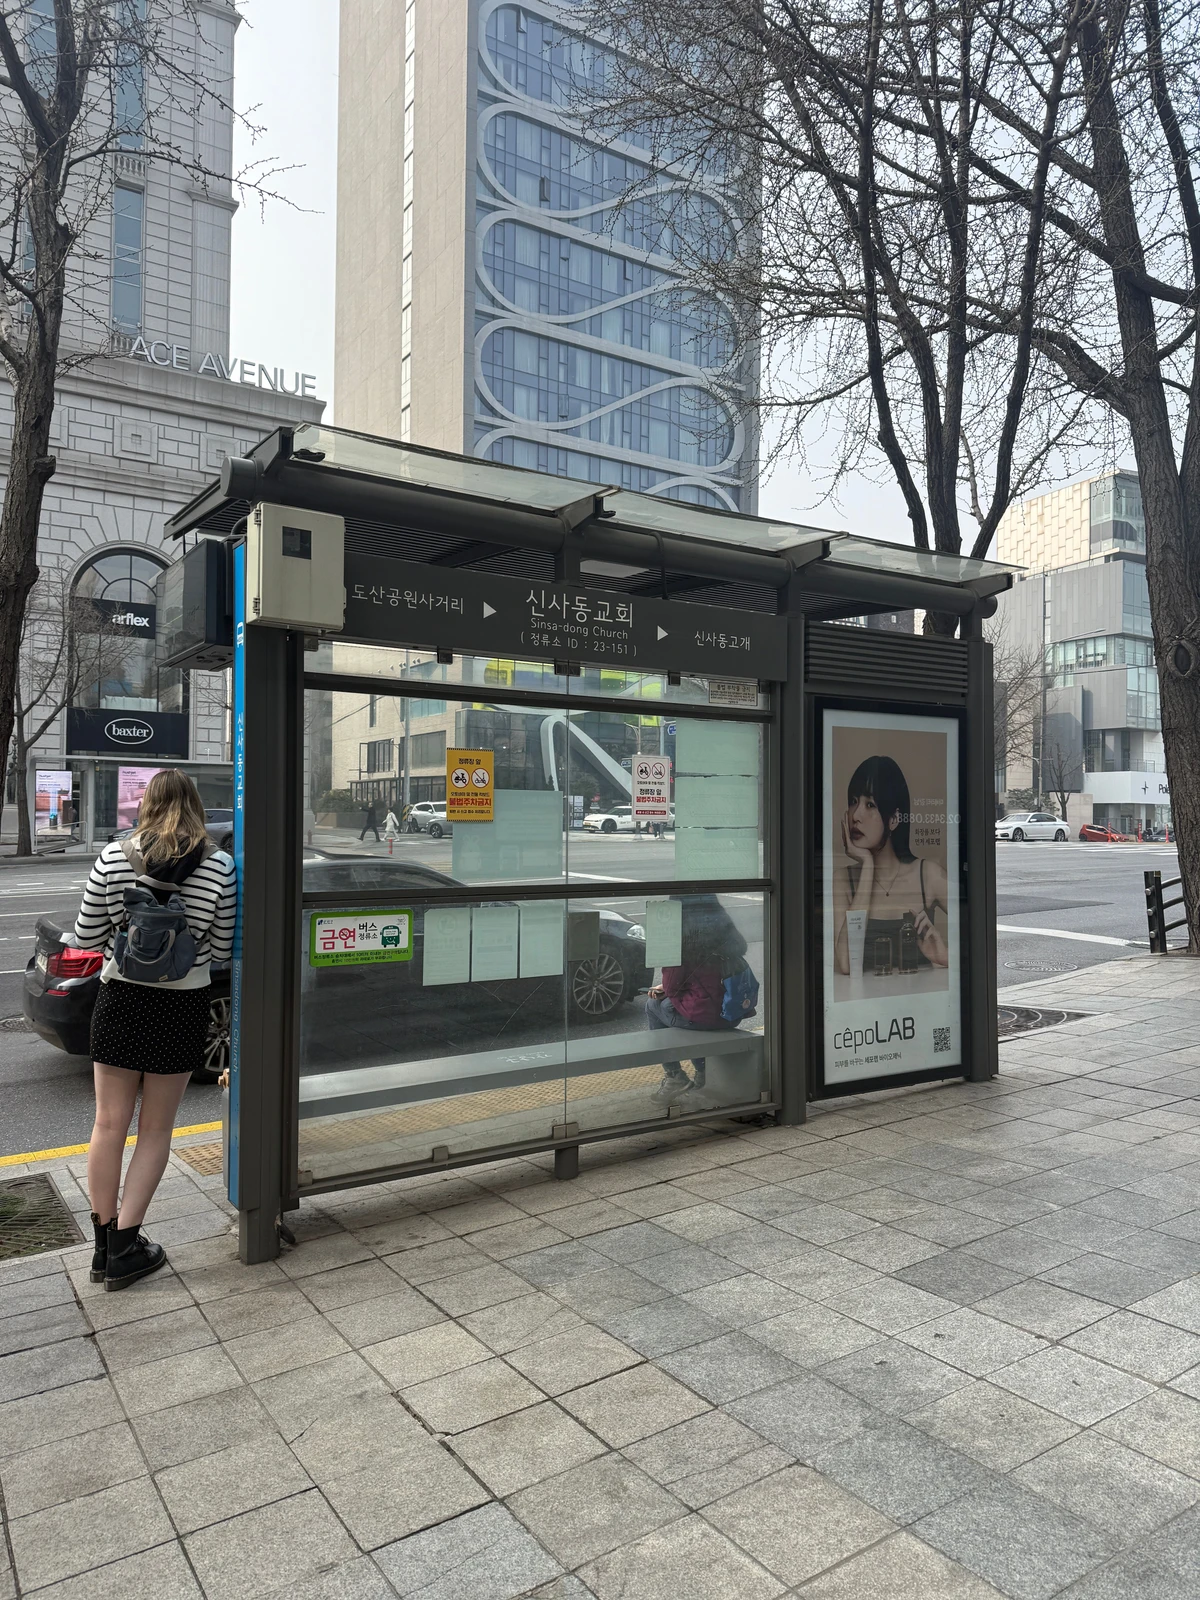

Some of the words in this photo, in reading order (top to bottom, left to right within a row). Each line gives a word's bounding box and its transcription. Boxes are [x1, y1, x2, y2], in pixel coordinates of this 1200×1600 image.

[130, 335, 190, 371] ACE
[198, 352, 317, 399] AVENUE
[352, 584, 463, 614] 도산공원사거리
[526, 590, 633, 628] 신사동교회
[112, 613, 150, 627] arflex
[530, 618, 589, 637] Sinsa-dong
[592, 626, 628, 640] Church
[530, 633, 562, 647] 정류소
[567, 638, 579, 649] ID
[593, 641, 628, 654] 23-151
[694, 631, 750, 651] 신사동고개
[112, 723, 149, 738] baxter
[449, 797, 492, 807] 불법주차금지
[639, 788, 655, 796] 정류장
[358, 922, 378, 932] 버스
[358, 933, 378, 941] 정류소
[320, 928, 356, 950] 금연
[834, 1017, 915, 1054] cêpoLAB
